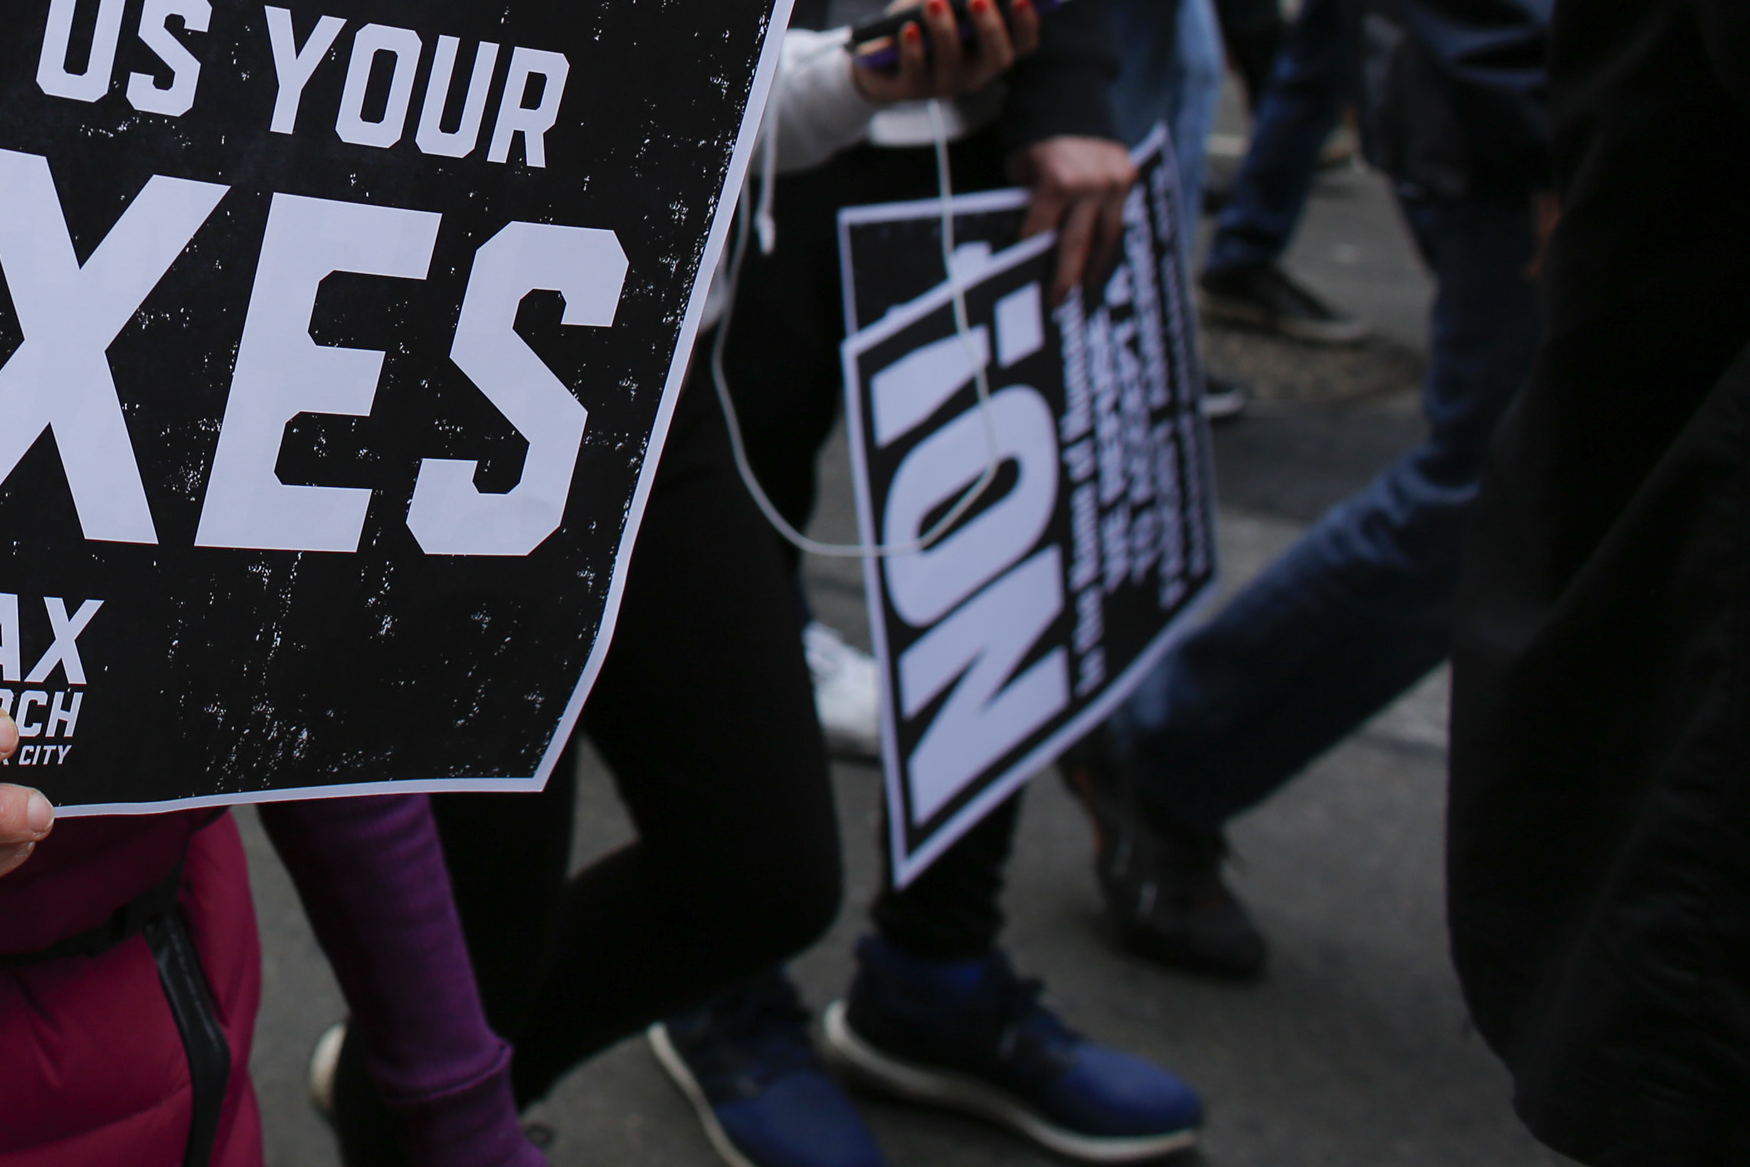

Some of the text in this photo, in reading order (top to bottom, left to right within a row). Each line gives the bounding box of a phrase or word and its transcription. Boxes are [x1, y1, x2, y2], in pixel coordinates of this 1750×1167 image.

[264, 5, 570, 168] YOUR
[869, 280, 1070, 828] NO!
[18, 744, 73, 766] CITY
